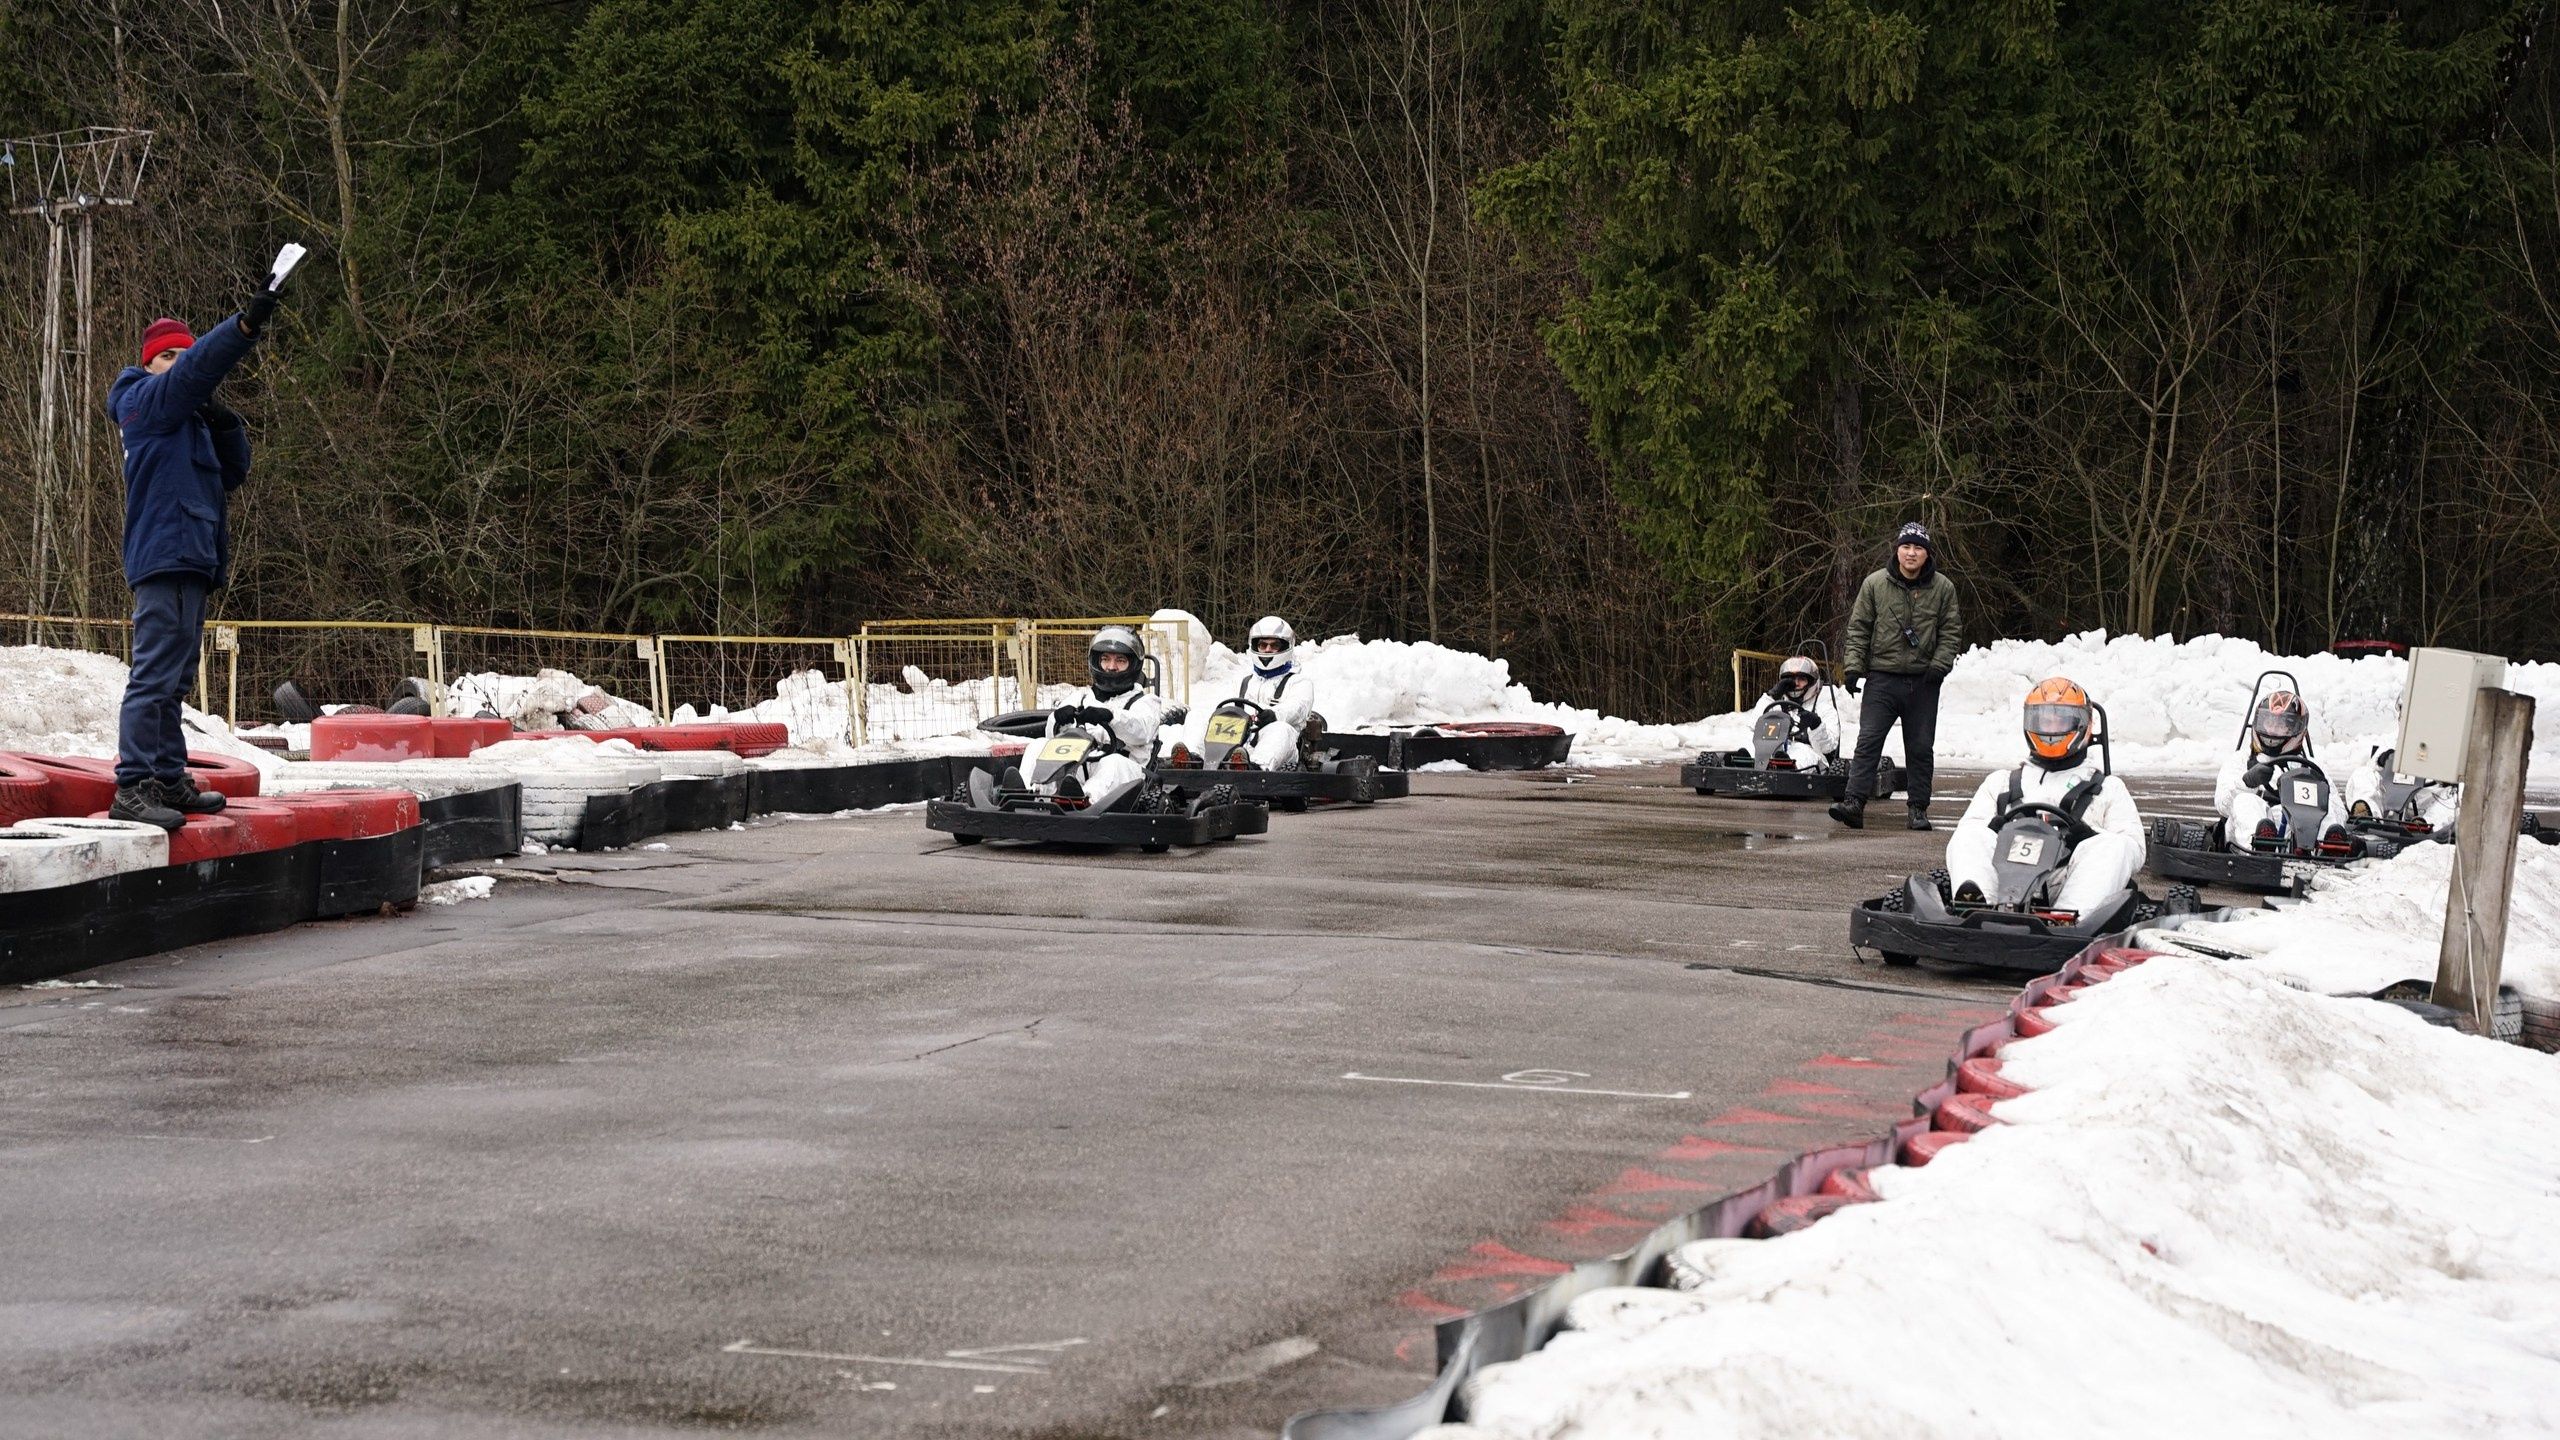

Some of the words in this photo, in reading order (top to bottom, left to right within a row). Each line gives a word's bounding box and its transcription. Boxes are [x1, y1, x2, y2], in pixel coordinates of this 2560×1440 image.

[1215, 723, 1237, 737] 14
[1768, 724, 1776, 736] 7
[1055, 744, 1072, 754] 6
[2302, 787, 2310, 800] 3
[2020, 842, 2033, 857] 5
